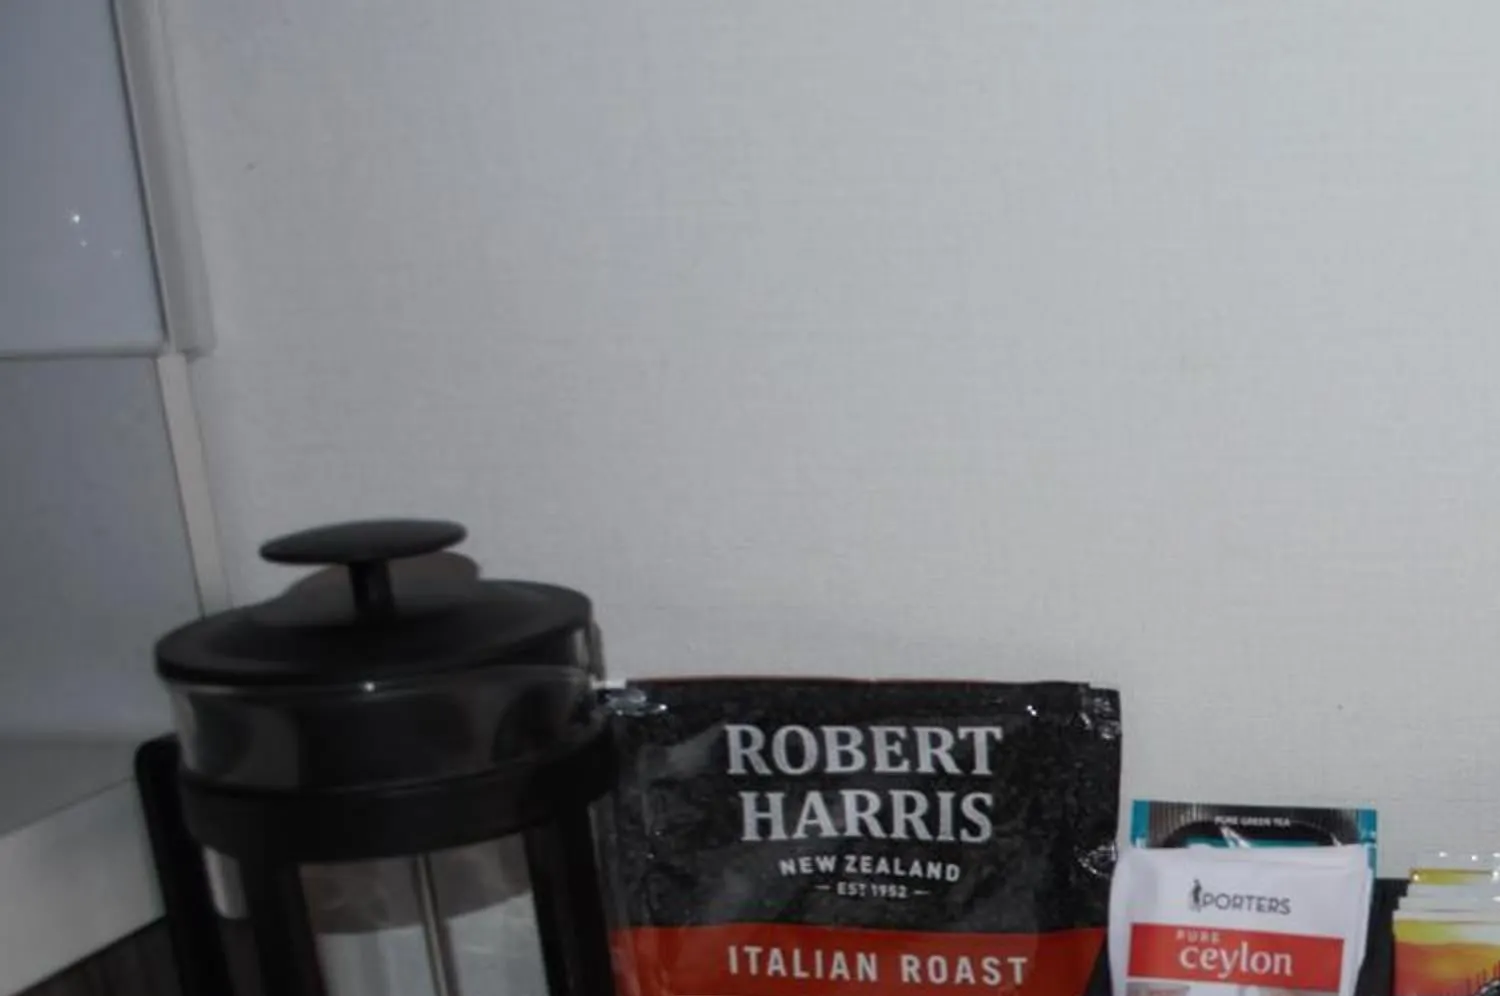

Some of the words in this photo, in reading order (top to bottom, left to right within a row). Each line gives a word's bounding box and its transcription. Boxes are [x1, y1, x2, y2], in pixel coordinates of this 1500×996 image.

[722, 724, 1003, 776] ROBERT
[739, 790, 995, 843] HARRIS
[779, 855, 837, 877] NEW
[844, 855, 961, 882] ZEALAND
[870, 883, 908, 898] 1952
[1201, 892, 1292, 916] PORTERS
[1176, 928, 1221, 945] PURE
[728, 946, 879, 982] ITALIAN
[901, 955, 1029, 986] ROAST
[1179, 940, 1294, 980] ceylon
